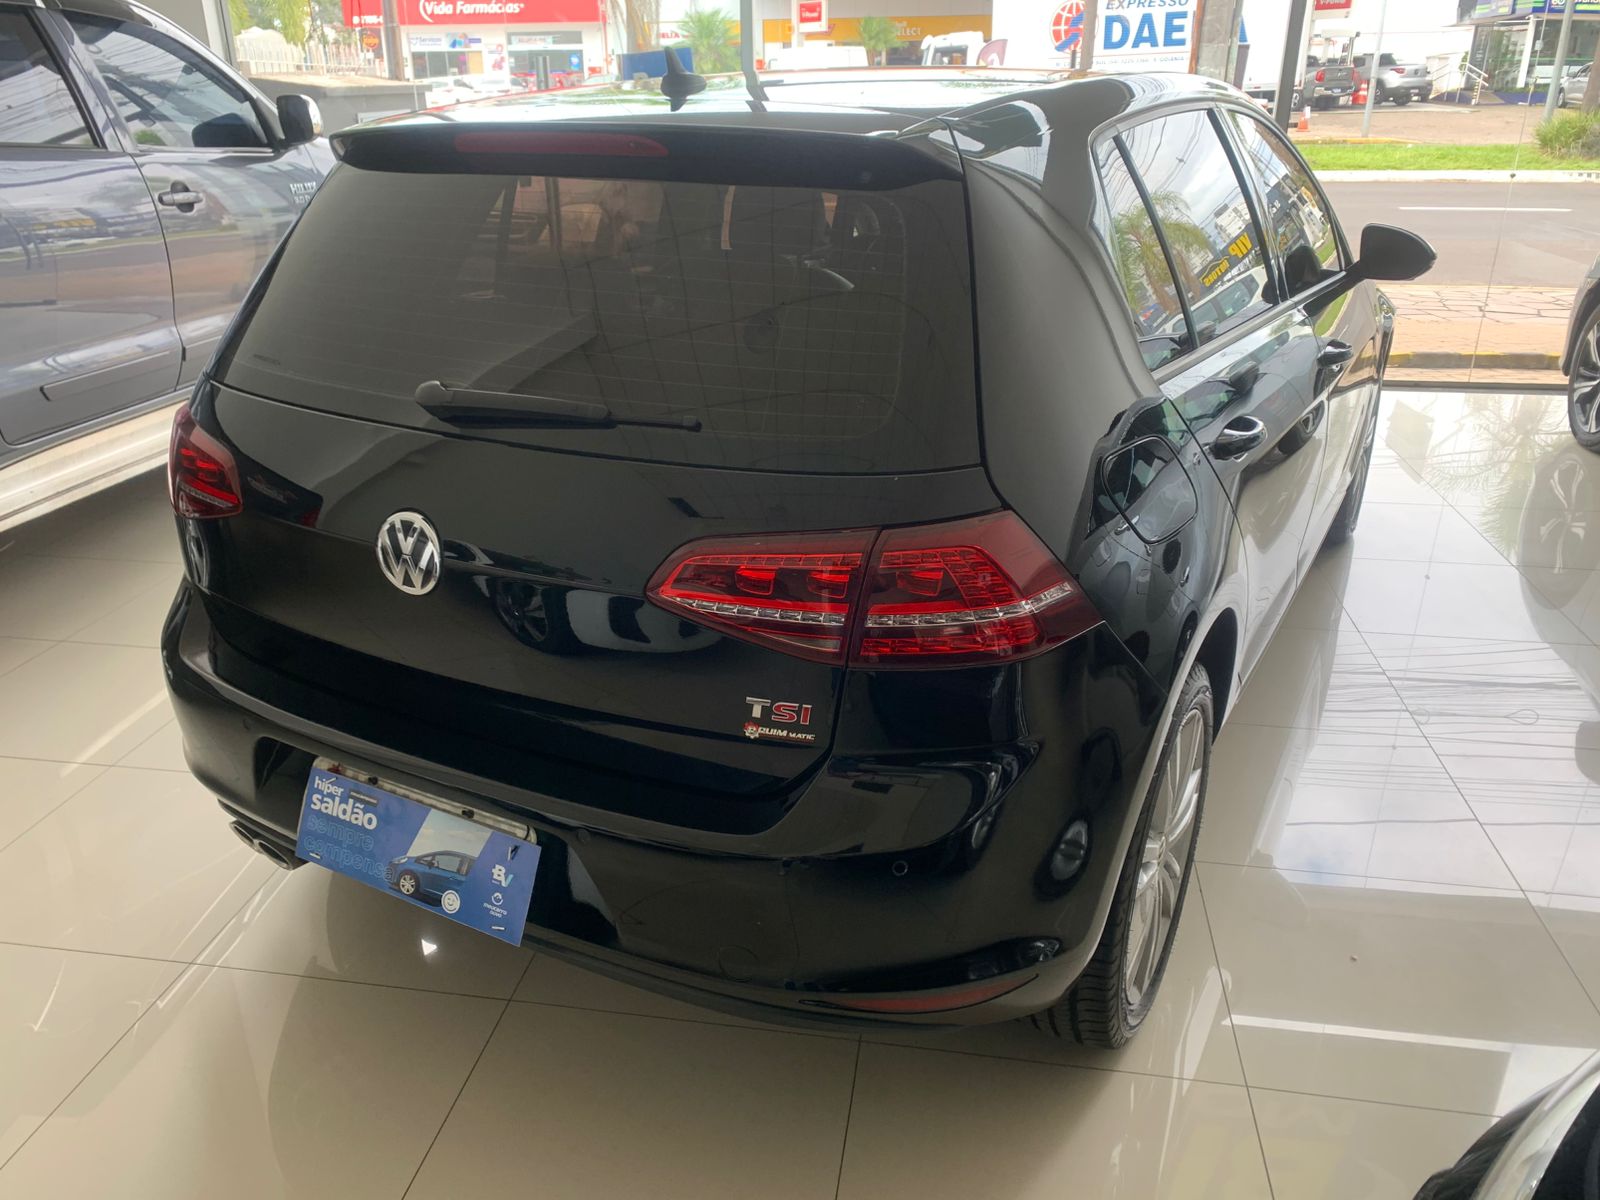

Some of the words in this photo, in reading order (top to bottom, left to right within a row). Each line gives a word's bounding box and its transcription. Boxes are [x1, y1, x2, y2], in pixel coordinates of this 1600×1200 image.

[424, 2, 453, 15] Vida
[1106, 0, 1189, 9] EXPRESSO
[745, 696, 812, 725] TSI
[311, 793, 377, 830] saldão
[307, 815, 374, 851] sempre
